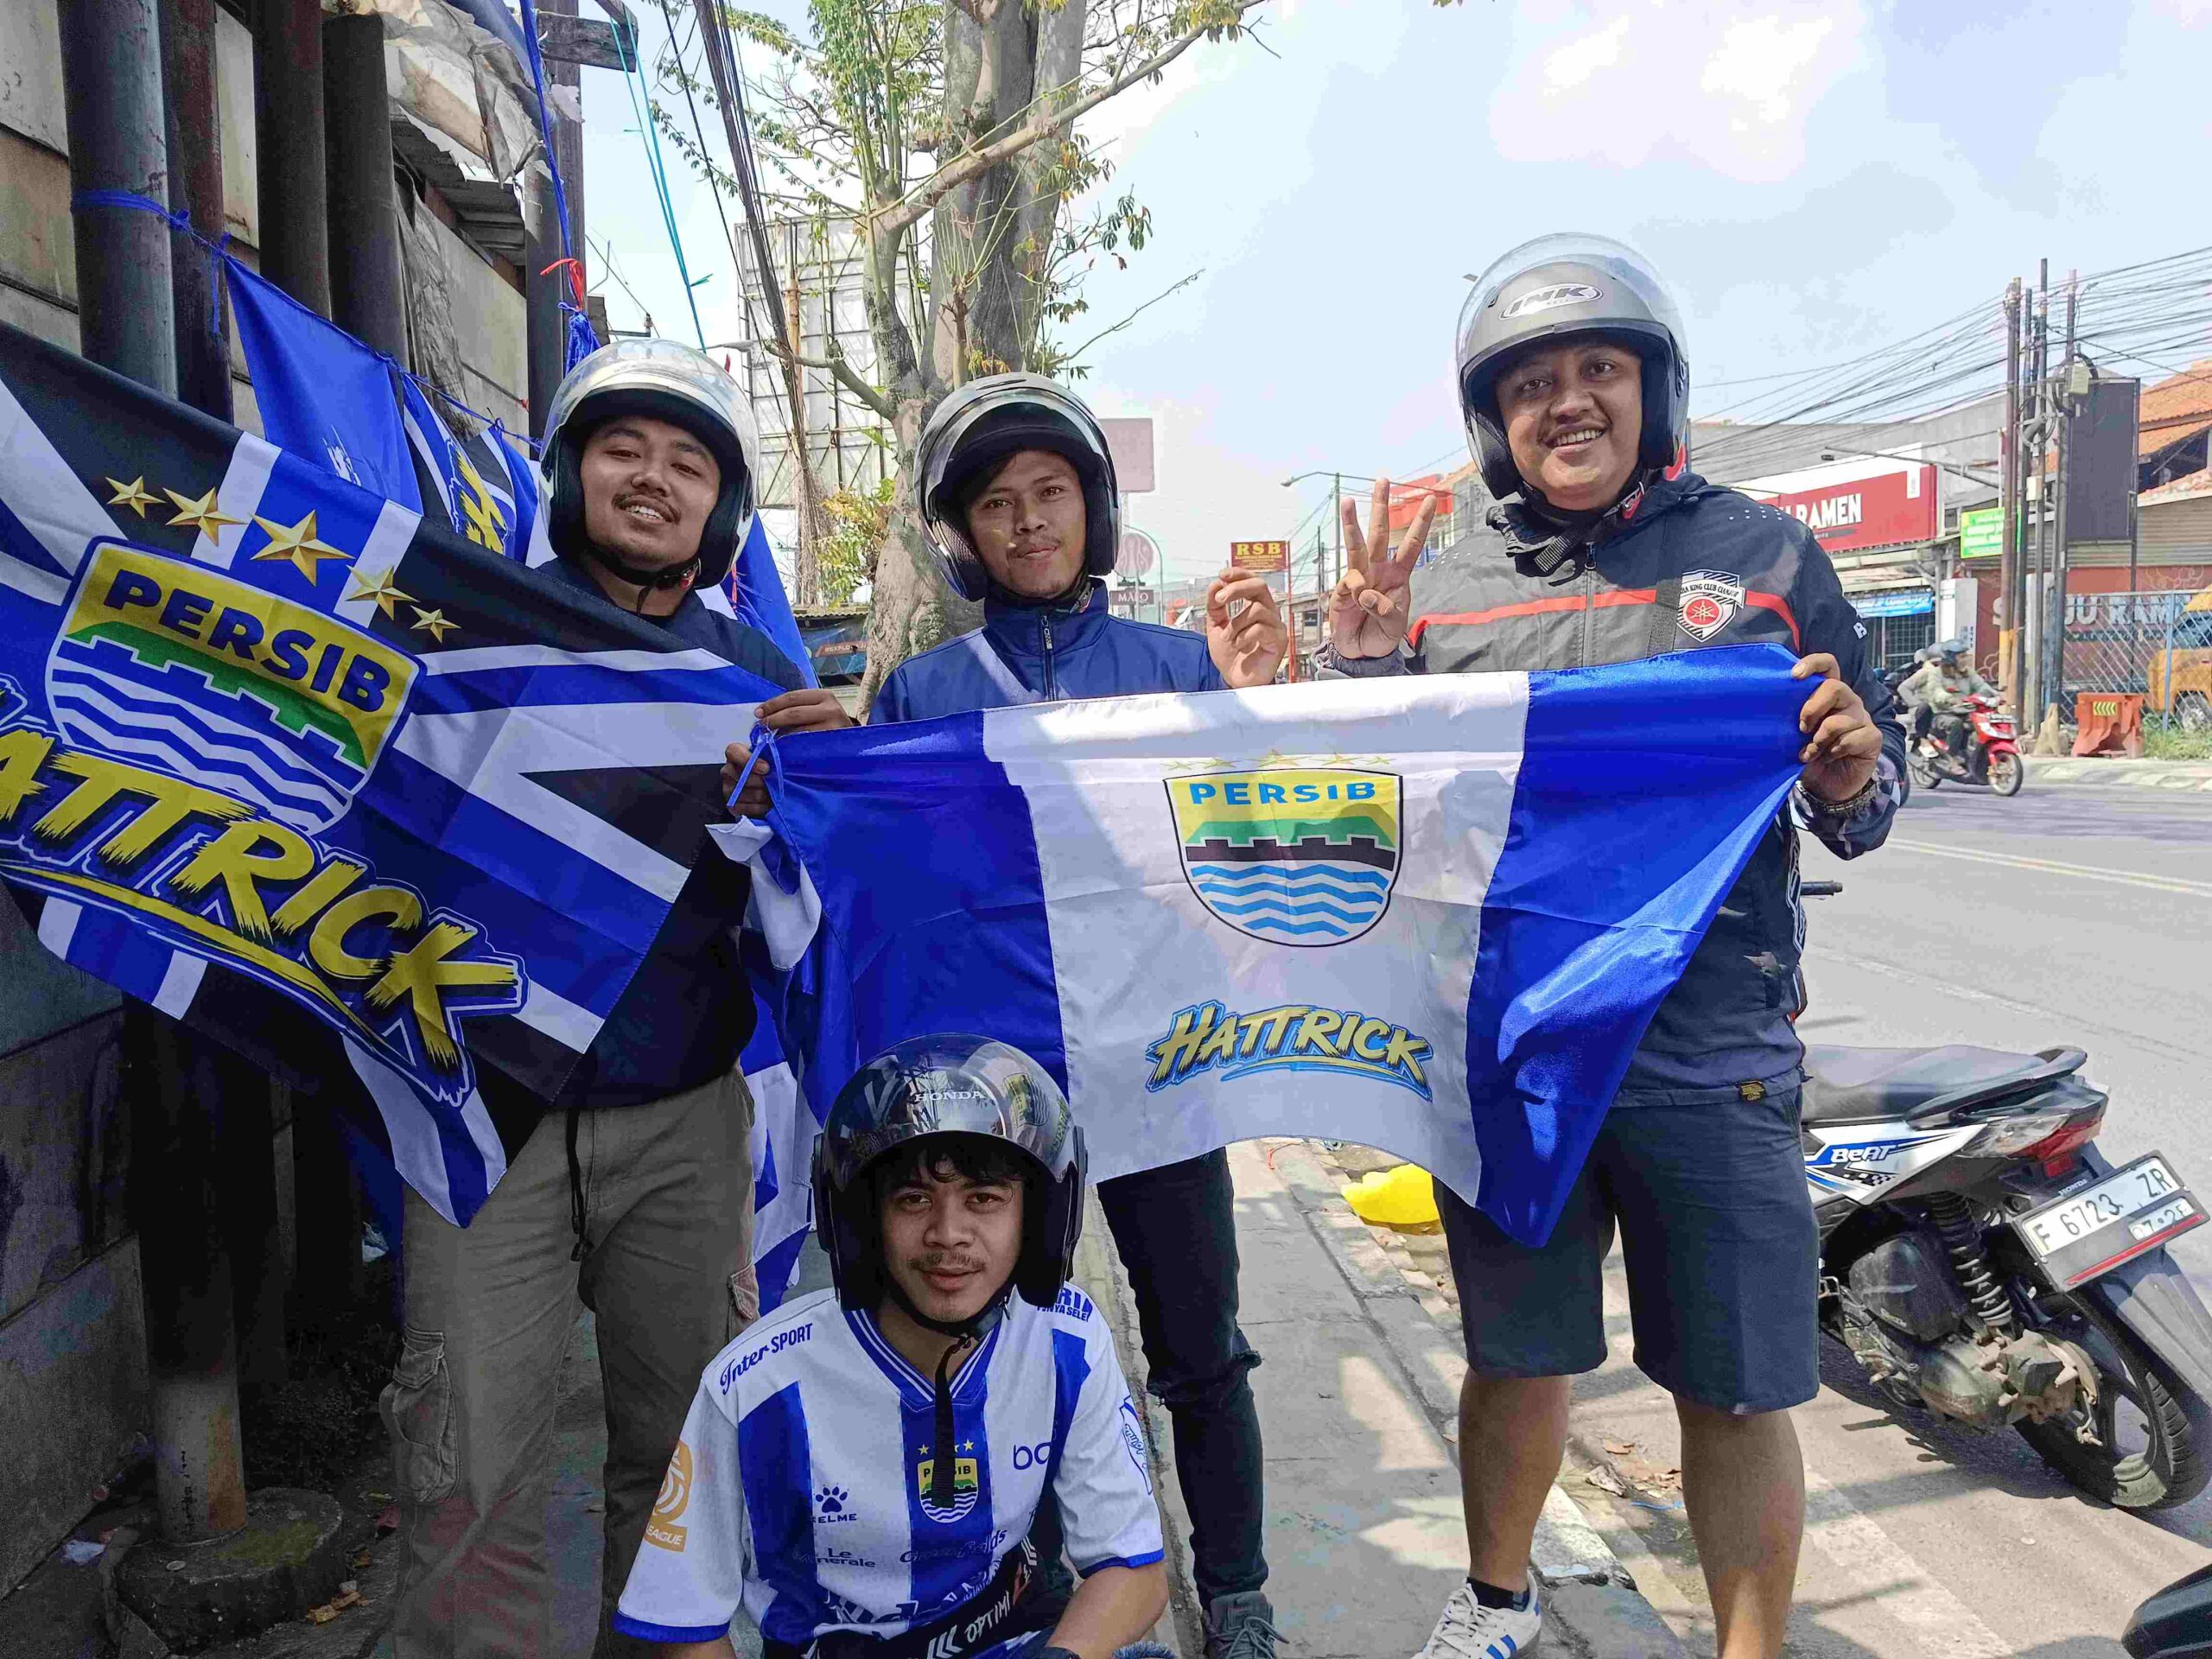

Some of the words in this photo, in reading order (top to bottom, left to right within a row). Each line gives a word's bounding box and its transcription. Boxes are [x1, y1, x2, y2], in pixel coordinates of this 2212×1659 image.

[1796, 493, 1862, 530] RAMEN
[1118, 592, 1149, 603] MAO
[102, 569, 391, 714] PERSIB
[1188, 781, 1376, 805] PERSIB
[0, 728, 518, 1071] ATTRICK
[1149, 1002, 1430, 1087] HATTRICK
[914, 1090, 987, 1103] HONDA
[2032, 1223, 2050, 1251] F
[2060, 1193, 2124, 1236] 6723
[2135, 1167, 2173, 1198] ZR
[828, 1548, 852, 1559] Le
